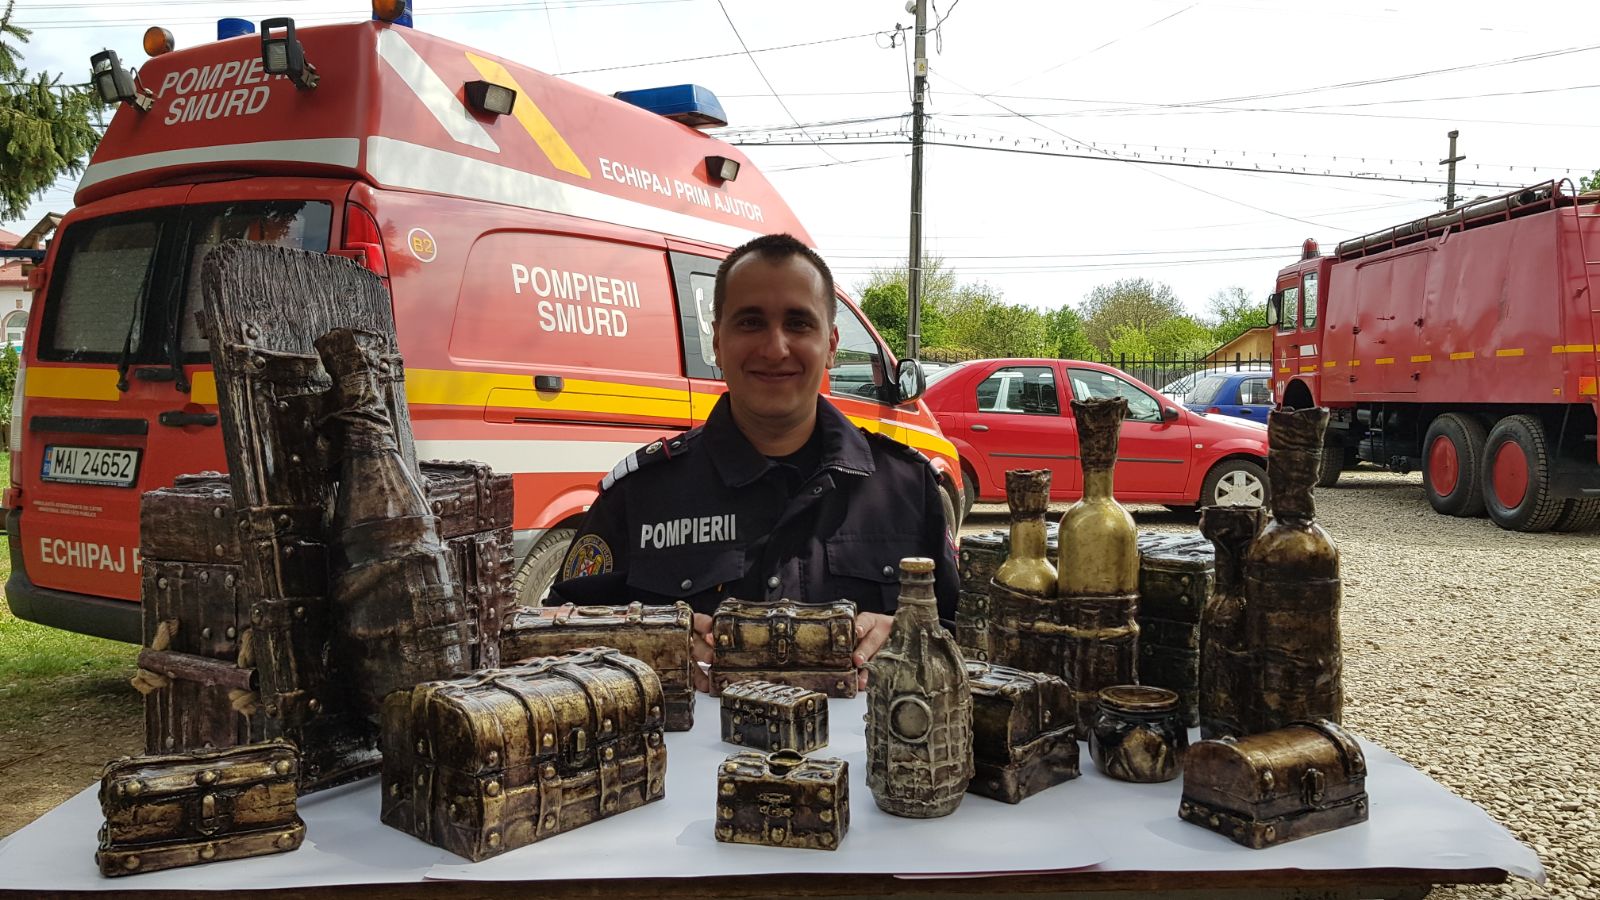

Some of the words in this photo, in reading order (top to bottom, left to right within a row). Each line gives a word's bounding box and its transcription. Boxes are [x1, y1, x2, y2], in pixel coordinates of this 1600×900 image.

[158, 57, 289, 98] POMPIE
[164, 85, 271, 126] SMURD
[599, 157, 672, 197] ECHIPAJ
[674, 179, 711, 208] PRIM
[715, 192, 764, 223] AJUTOR
[412, 235, 433, 253] B2
[511, 263, 640, 308] POMPIERII
[537, 300, 628, 337] SMURD
[54, 449, 78, 475] MAI
[80, 451, 131, 478] 24652
[640, 514, 736, 549] POMPIERII
[40, 537, 126, 573] ECHIPAJ
